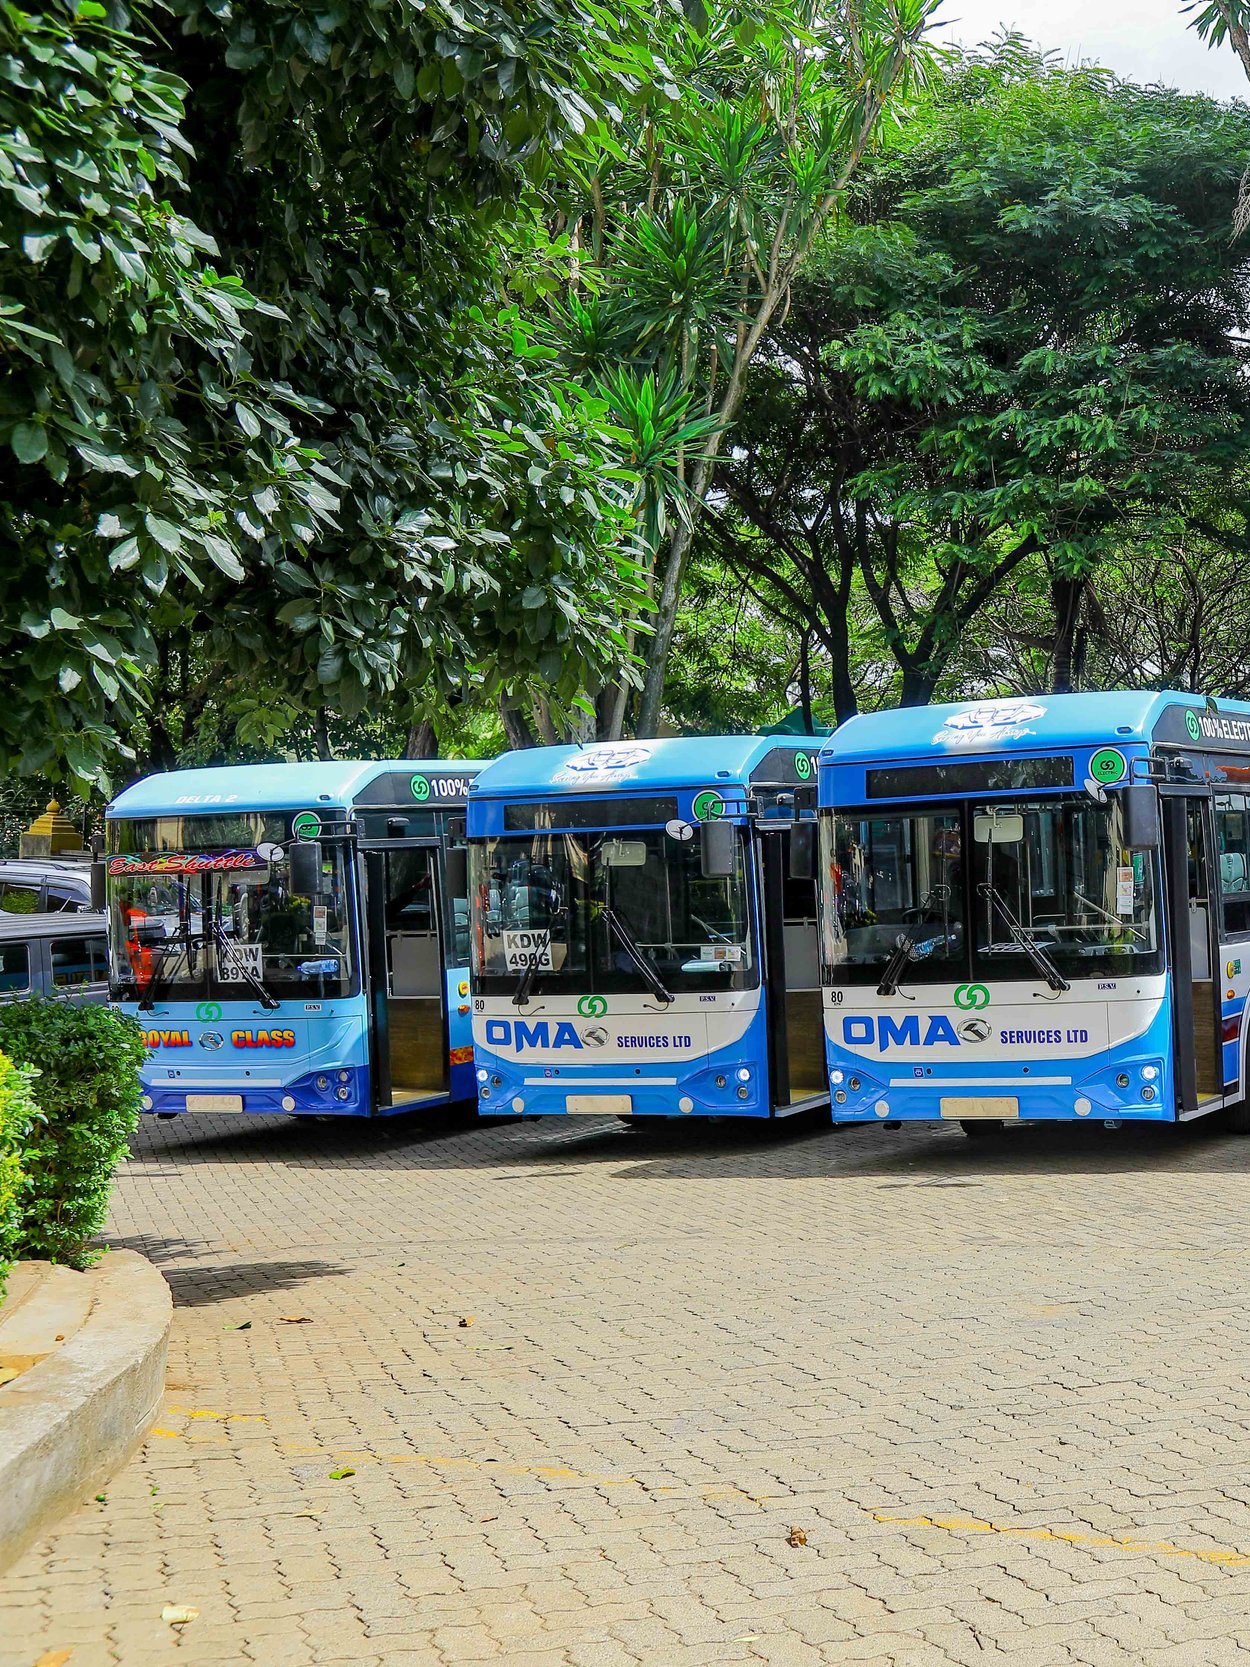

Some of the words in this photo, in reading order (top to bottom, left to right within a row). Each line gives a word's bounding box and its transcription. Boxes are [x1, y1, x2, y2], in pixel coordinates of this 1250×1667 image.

[1198, 716, 1223, 738] 100%
[431, 778, 468, 797] 100%
[175, 794, 222, 804] DELTA
[224, 794, 239, 803] 2
[108, 857, 160, 875] East
[163, 853, 256, 870] Shuttle
[507, 933, 549, 949] KDW
[510, 952, 550, 967] 490G
[475, 999, 485, 1010] 80
[831, 990, 844, 1003] 80
[138, 1029, 193, 1047] ROYAL
[231, 1029, 296, 1048] CLASS
[485, 1019, 584, 1054] OMA
[617, 1035, 668, 1048] SERVICES
[673, 1034, 691, 1048] LTD
[842, 1015, 961, 1053] OMA
[1000, 1030, 1062, 1044] SERVICES
[1067, 1029, 1088, 1043] LTD
